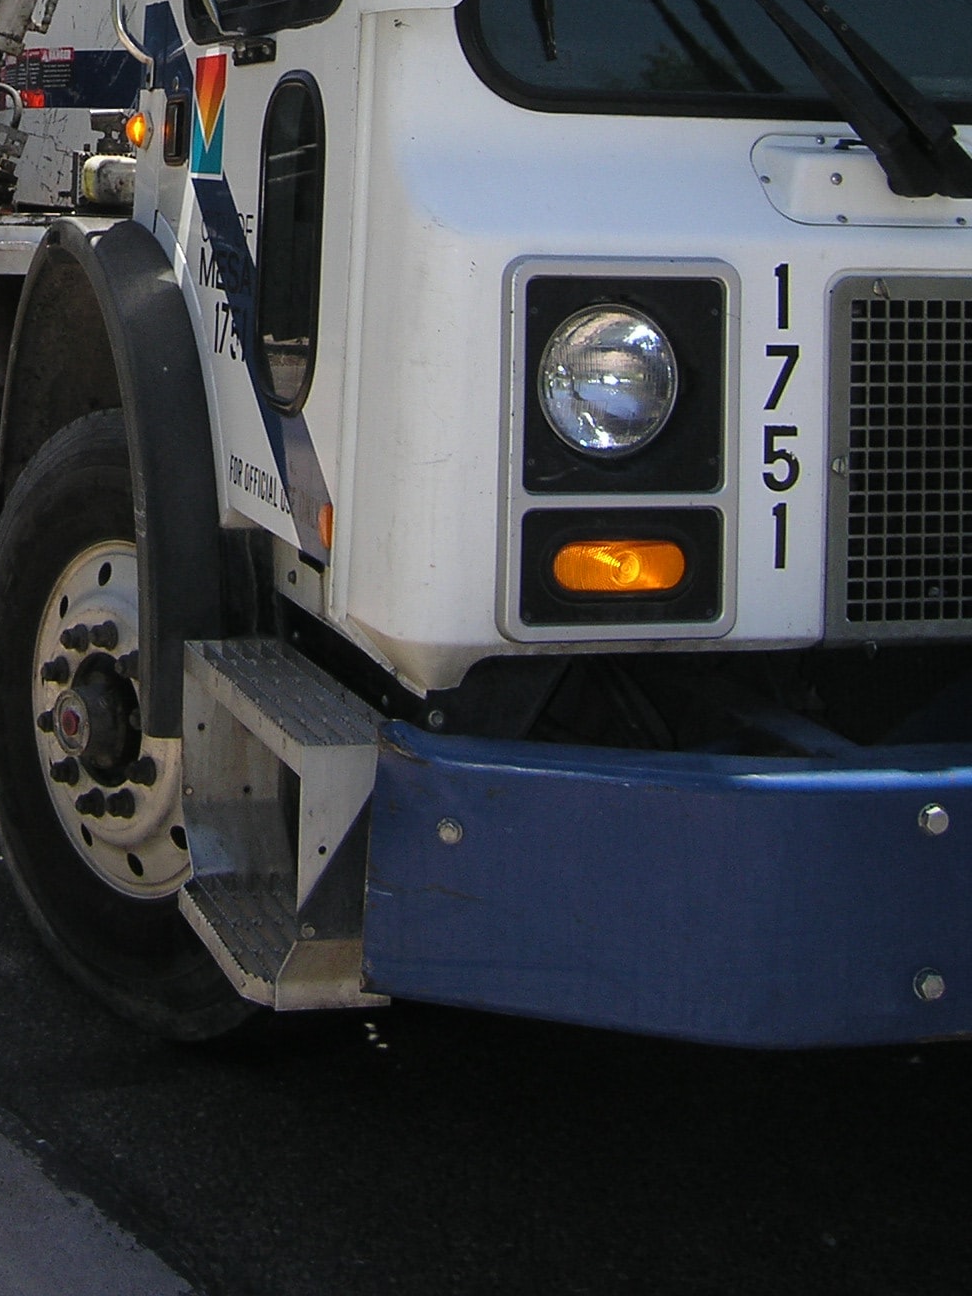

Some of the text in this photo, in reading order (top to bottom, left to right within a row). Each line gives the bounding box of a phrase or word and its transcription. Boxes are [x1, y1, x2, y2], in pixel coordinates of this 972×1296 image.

[229, 454, 243, 488] FOR
[244, 462, 278, 508] OFFICIAL
[762, 263, 800, 569] 1751
